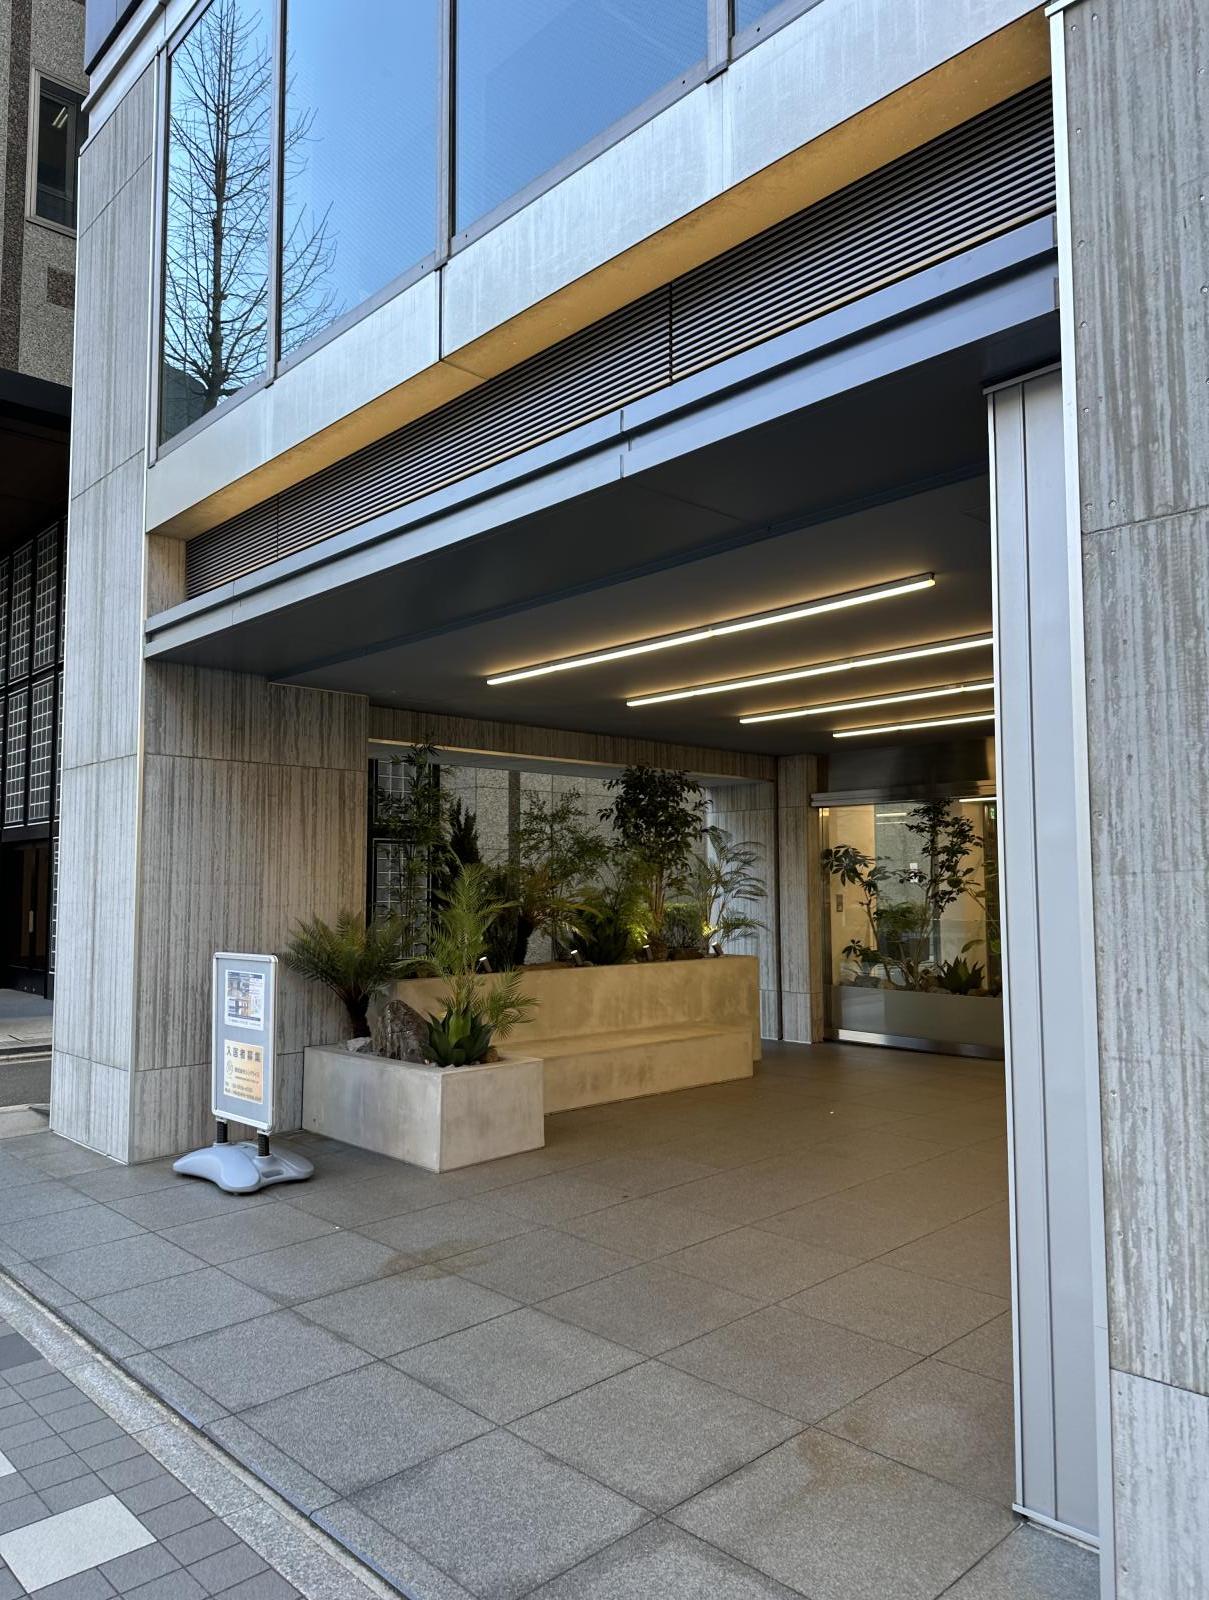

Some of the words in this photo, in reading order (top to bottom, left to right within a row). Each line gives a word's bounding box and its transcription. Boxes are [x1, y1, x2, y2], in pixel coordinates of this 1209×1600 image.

[226, 1046, 262, 1062] 入居者募集
